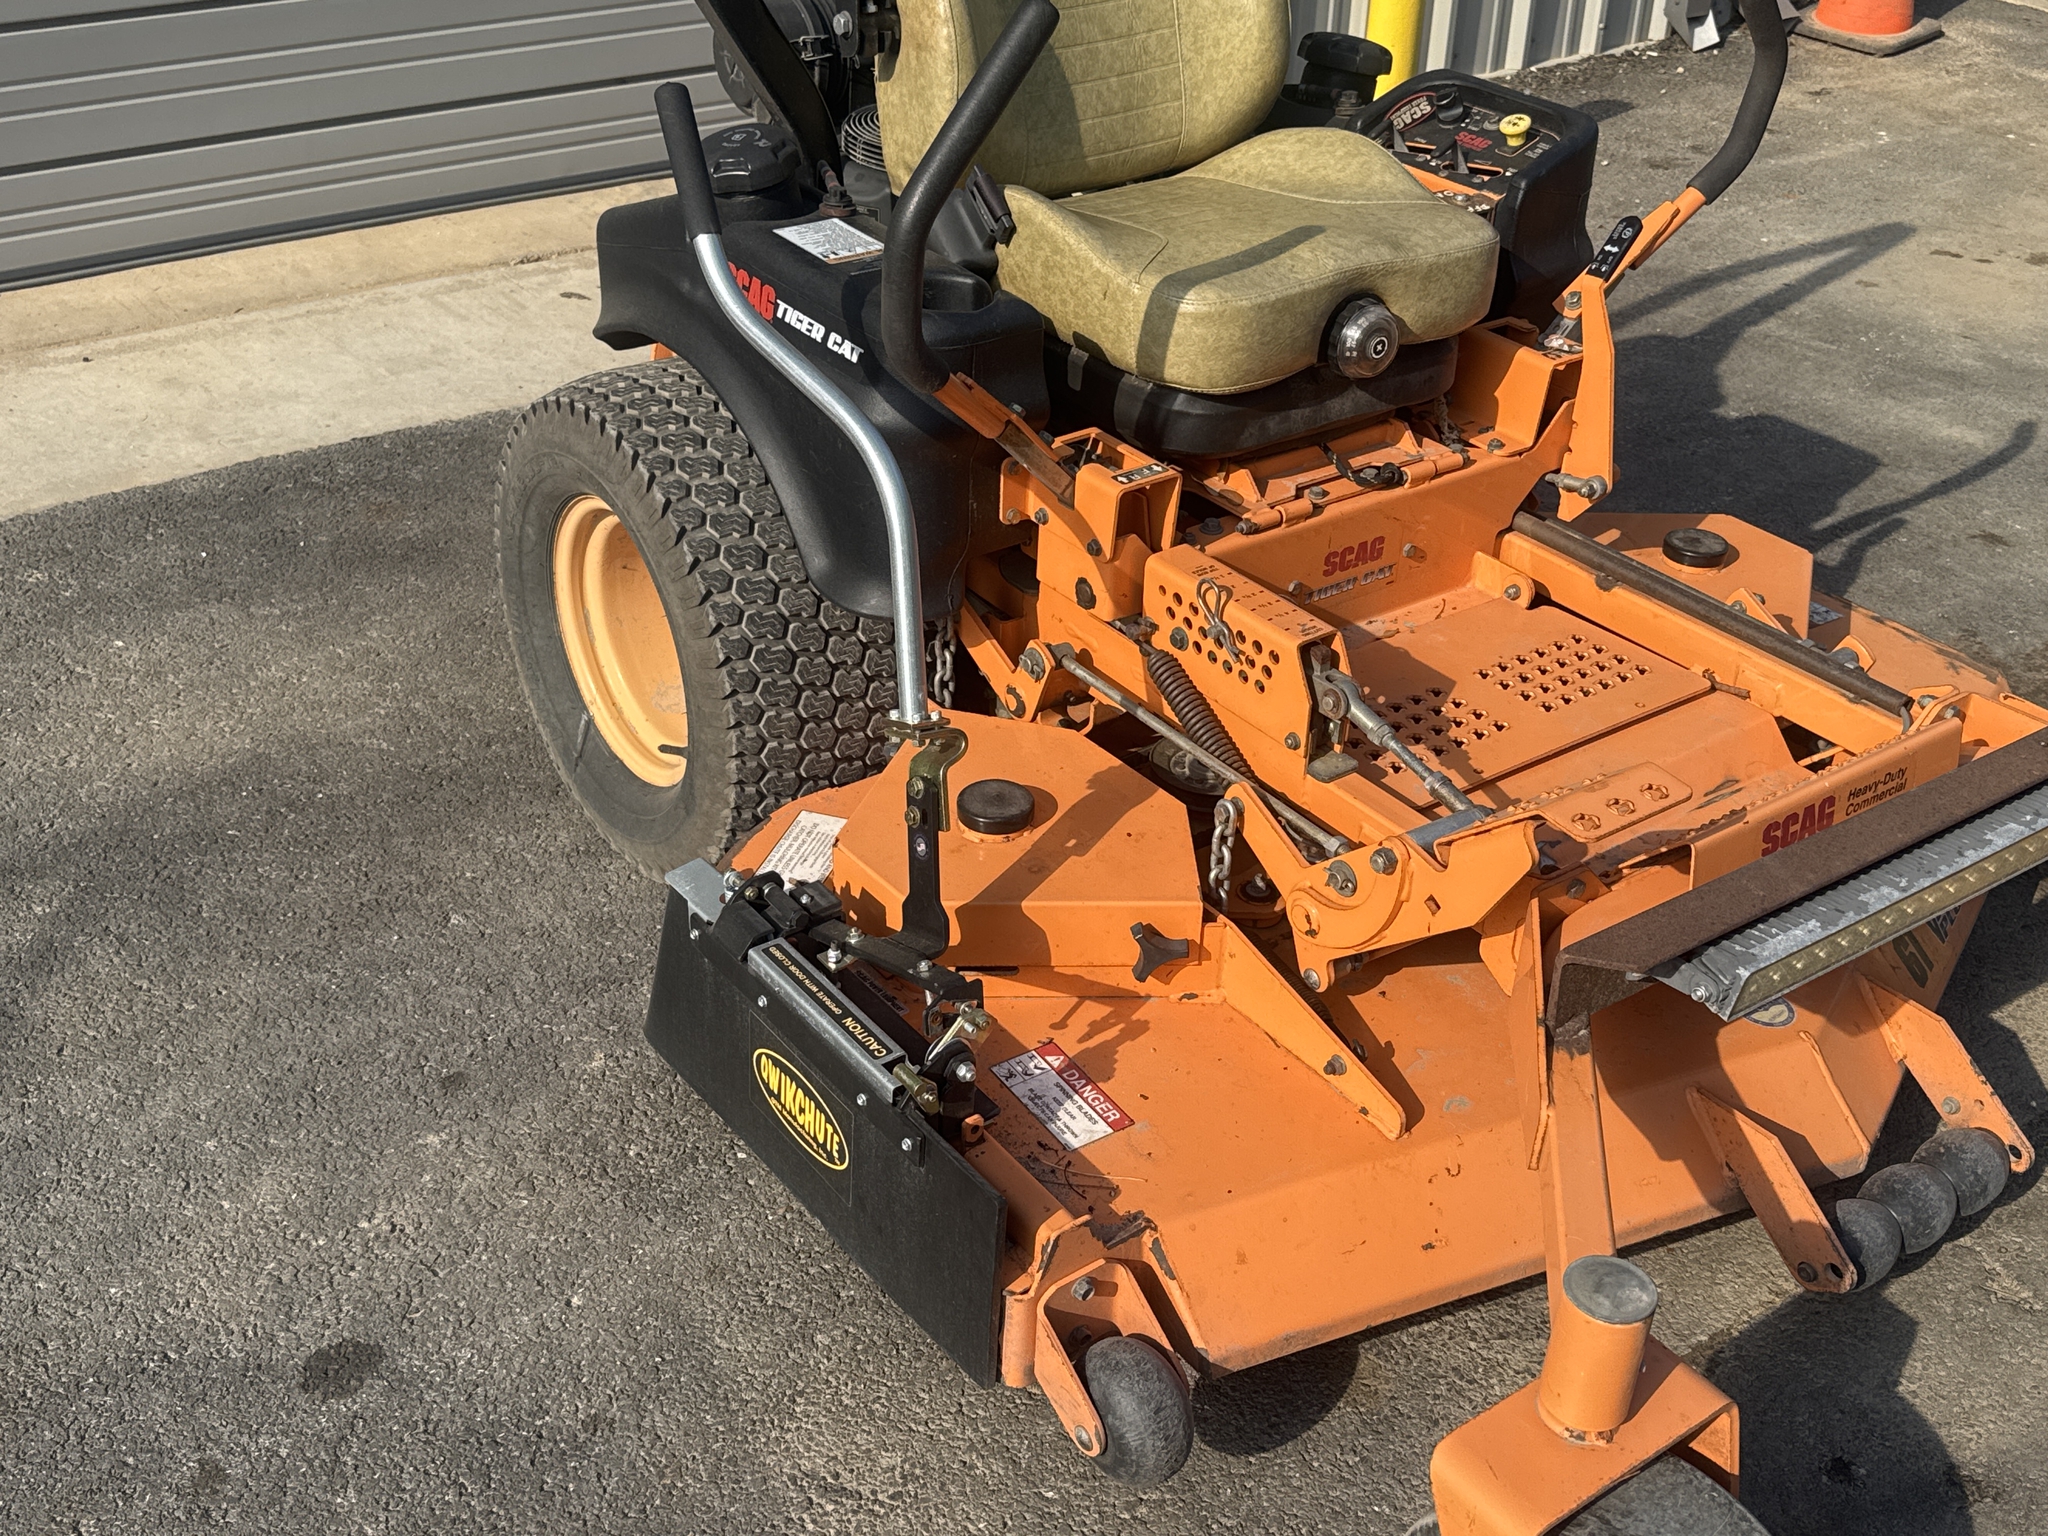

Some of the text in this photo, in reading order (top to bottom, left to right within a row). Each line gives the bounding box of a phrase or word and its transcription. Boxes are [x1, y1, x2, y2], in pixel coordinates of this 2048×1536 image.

[1393, 102, 1432, 130] SCAG
[1455, 131, 1493, 149] SCAG
[776, 299, 826, 343] TIGER
[826, 331, 864, 364] CAT
[1322, 535, 1386, 578] SCAG
[1304, 561, 1398, 605] TIGER CAT
[1845, 778, 1908, 817] Commercial
[1847, 767, 1908, 802] Heavy-Duty
[1761, 795, 1837, 857] SCAG
[1891, 930, 1934, 989] 61
[768, 946, 887, 1057] CAUTION OPERATE WITH DOOR CLOSED
[760, 1053, 840, 1159] QWIKCHUTE
[1053, 1081, 1099, 1126] SPINNING BLADES
[1062, 1069, 1121, 1123] DANGER
[1062, 1106, 1077, 1120] CLEAR
[1060, 1120, 1079, 1139] THROWN
